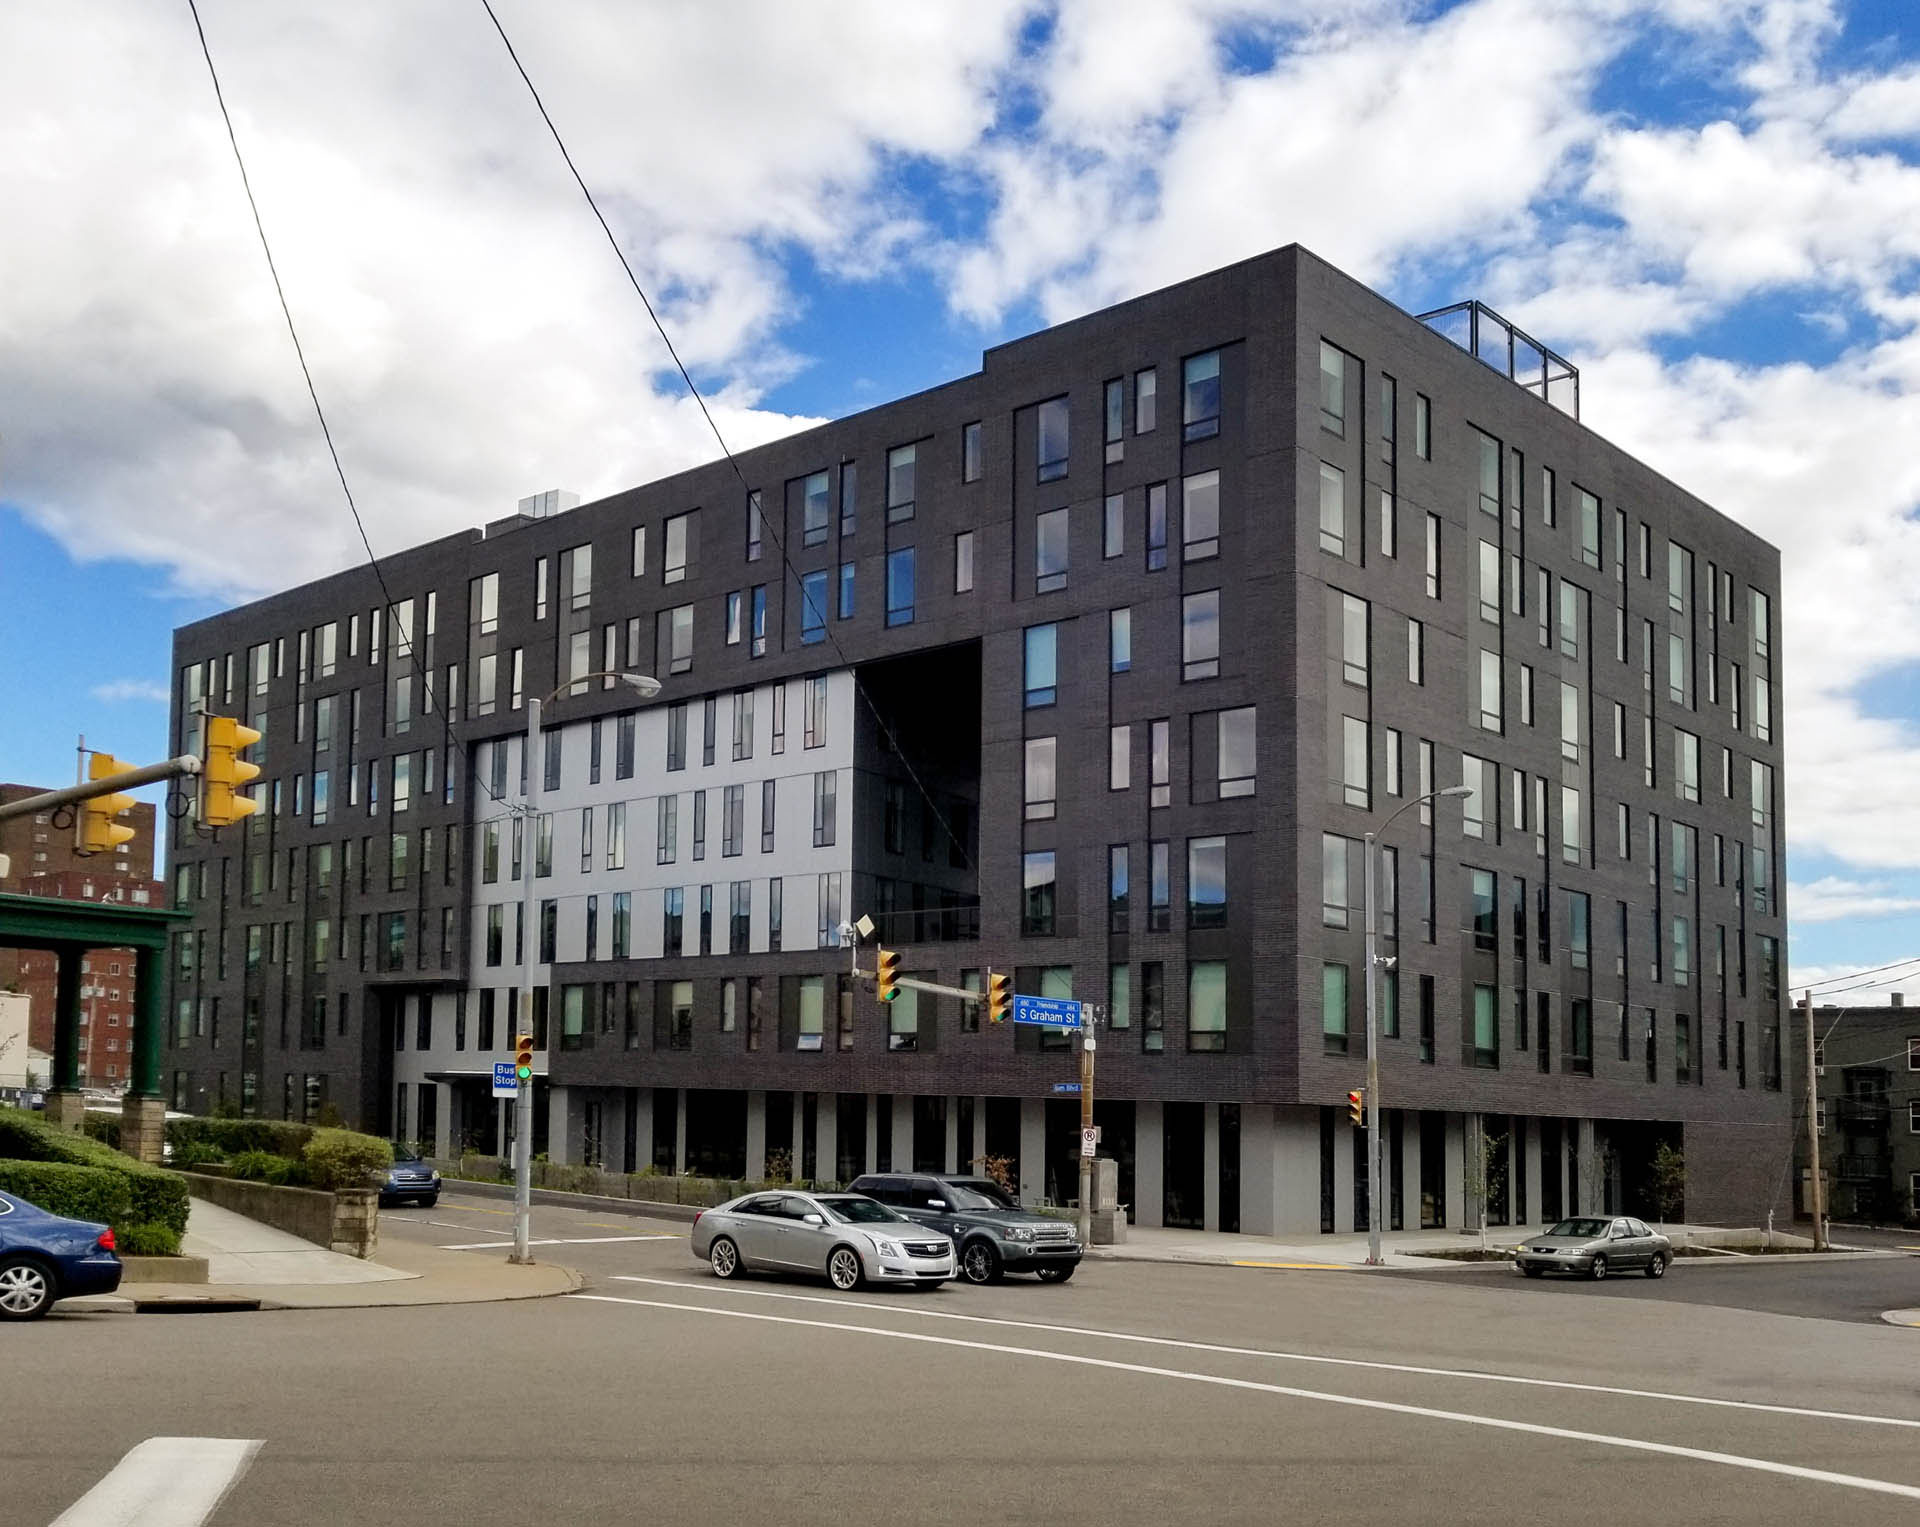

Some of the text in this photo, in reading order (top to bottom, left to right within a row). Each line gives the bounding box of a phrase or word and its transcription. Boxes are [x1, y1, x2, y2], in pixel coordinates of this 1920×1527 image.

[1020, 1008, 1075, 1024] S Graham St
[497, 1065, 515, 1074] Bus
[495, 1076, 516, 1086] Stop
